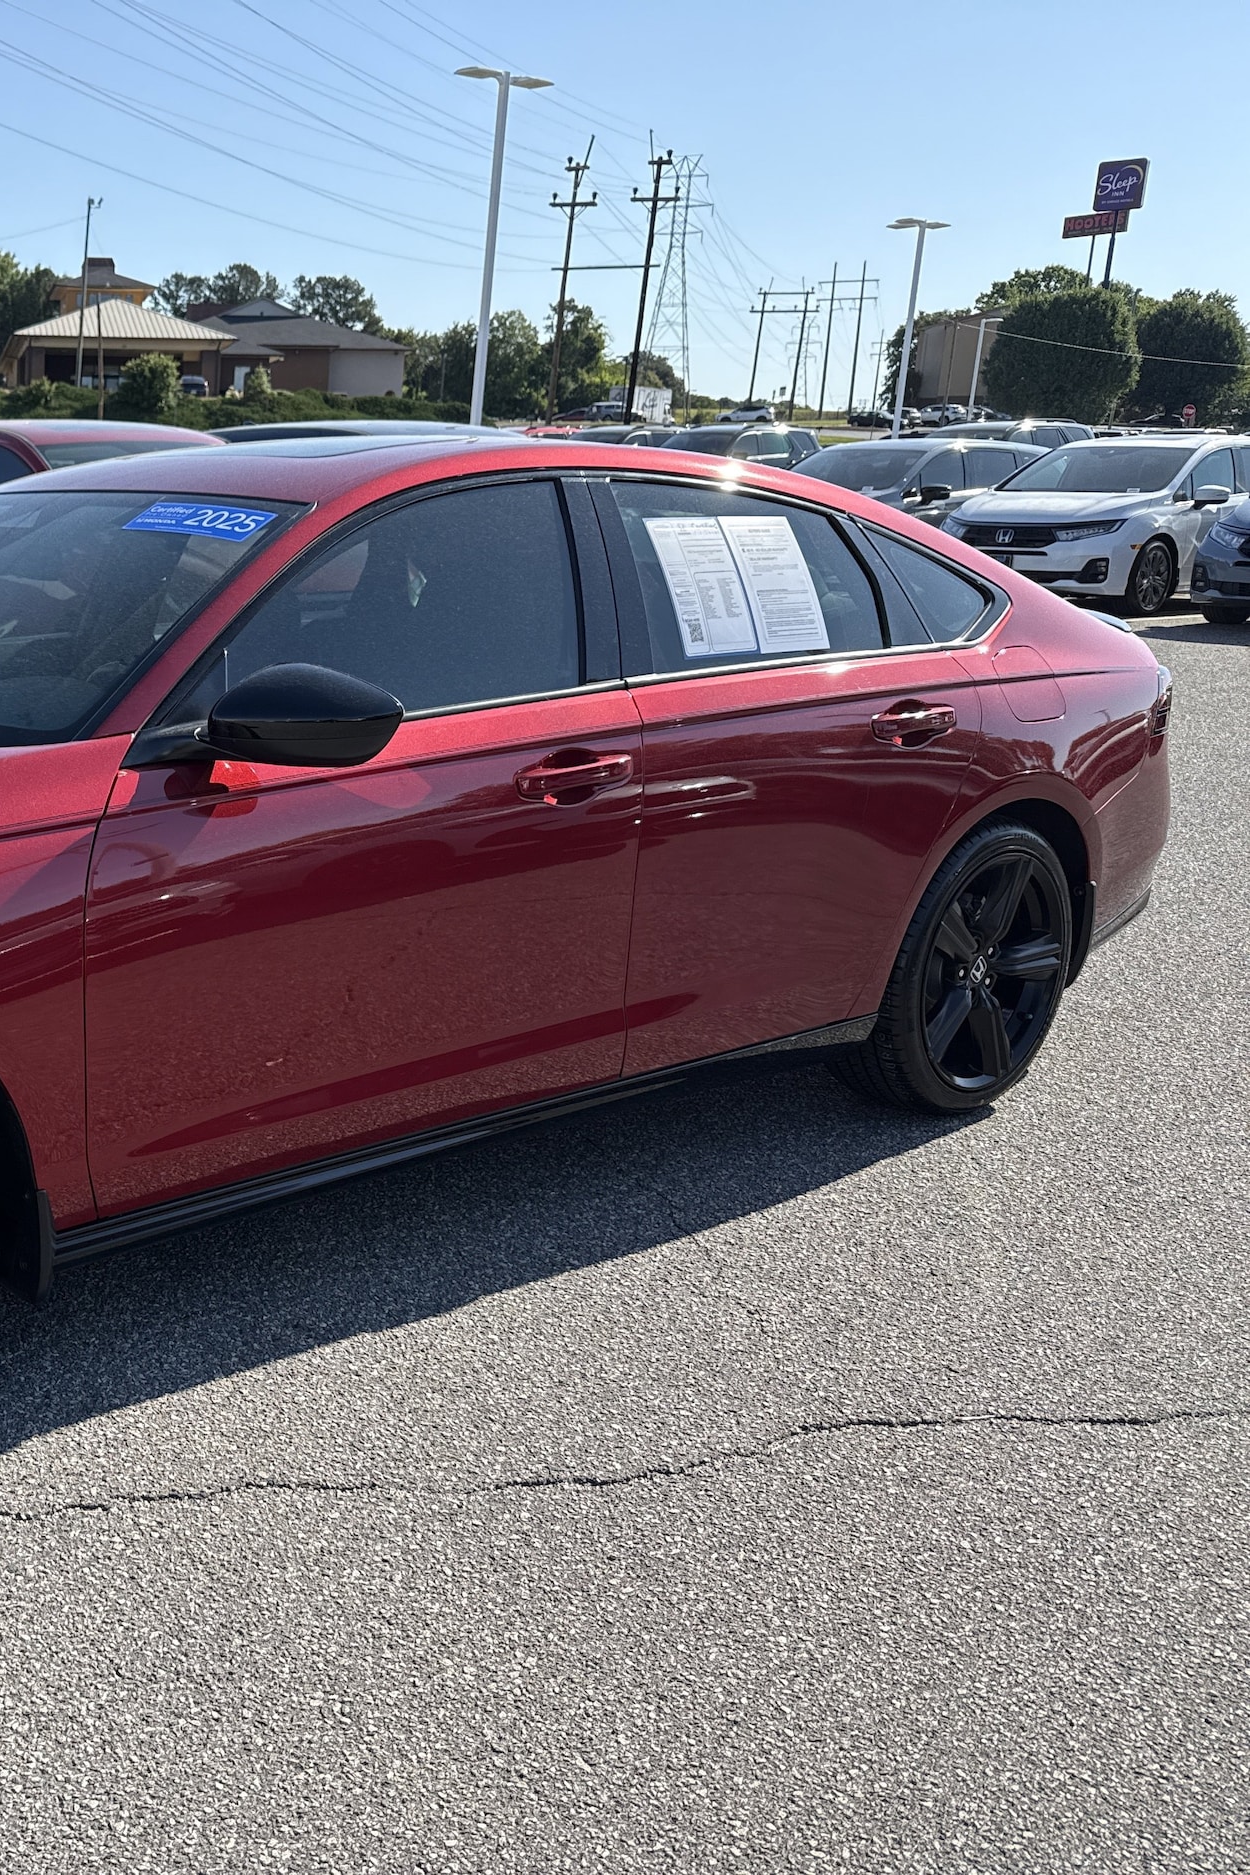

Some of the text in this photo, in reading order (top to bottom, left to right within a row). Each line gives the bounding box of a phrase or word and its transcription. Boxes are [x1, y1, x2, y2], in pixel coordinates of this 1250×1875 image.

[1097, 172, 1139, 196] Sleep
[150, 505, 196, 514] Certified
[182, 509, 266, 533] 2025
